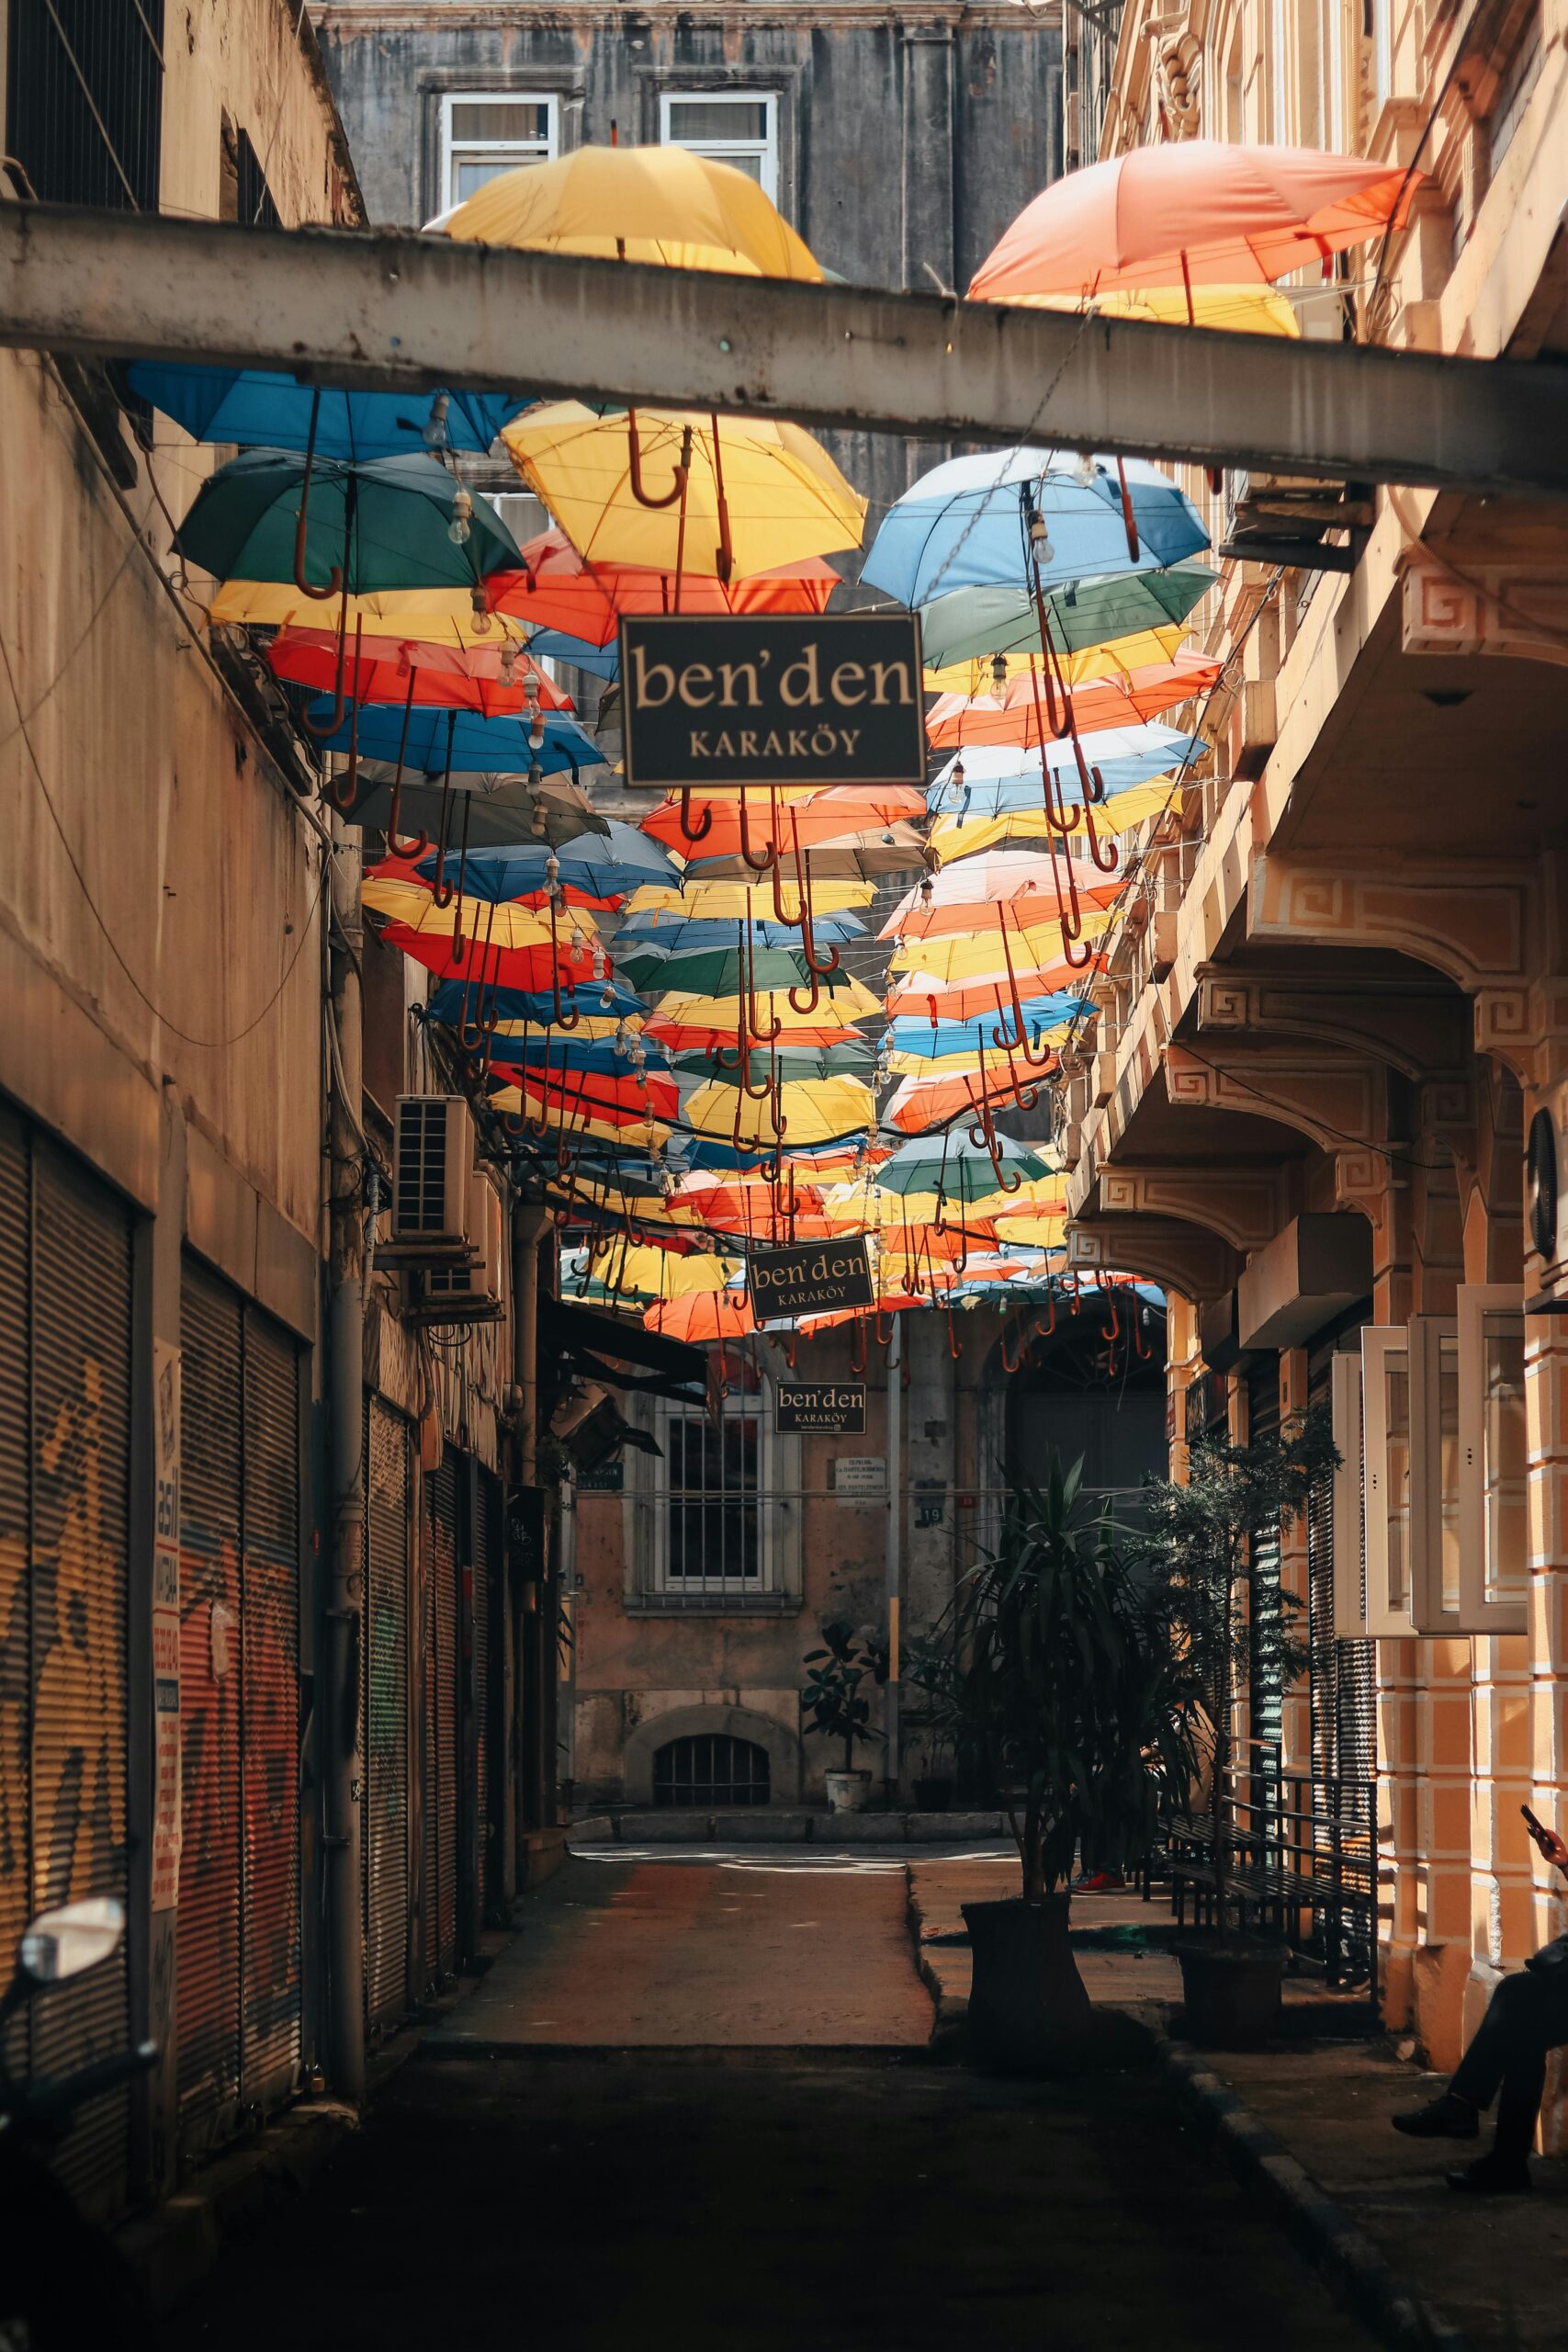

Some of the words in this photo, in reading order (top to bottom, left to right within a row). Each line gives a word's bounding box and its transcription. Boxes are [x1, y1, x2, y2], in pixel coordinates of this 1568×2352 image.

[630, 643, 914, 708] ben'den
[690, 724, 862, 758] KARAKÖY
[751, 1254, 866, 1290] ben'den
[777, 1285, 846, 1306] KARAKÖY
[778, 1387, 864, 1408] ben'den
[795, 1412, 847, 1423] KARAKÖY
[924, 1509, 940, 1521] 19
